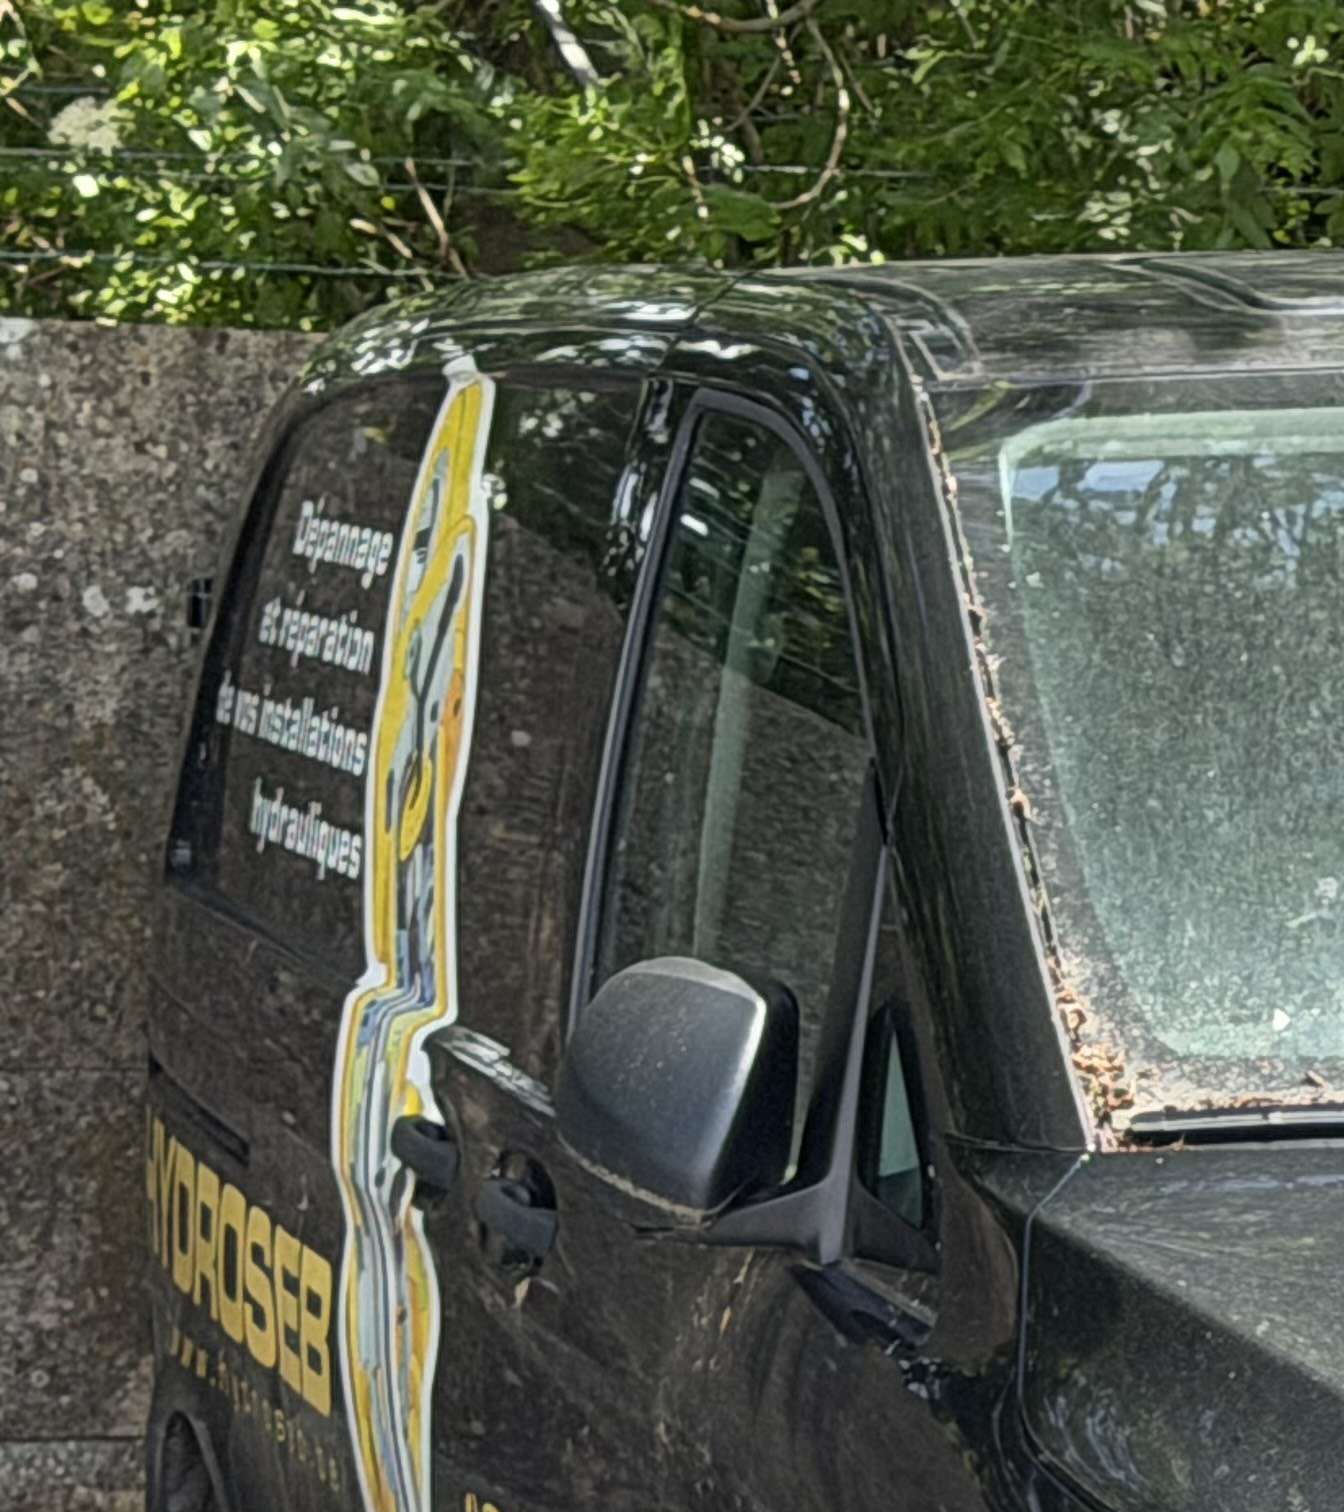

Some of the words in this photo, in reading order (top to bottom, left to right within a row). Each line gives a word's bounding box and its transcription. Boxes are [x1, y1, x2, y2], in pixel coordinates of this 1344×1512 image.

[293, 492, 393, 590] Dépannage
[258, 596, 281, 646] et
[278, 589, 375, 676] réparation
[257, 682, 368, 777] installations
[250, 776, 362, 881] hydrauliques
[147, 1105, 332, 1418] HYDROSEB
